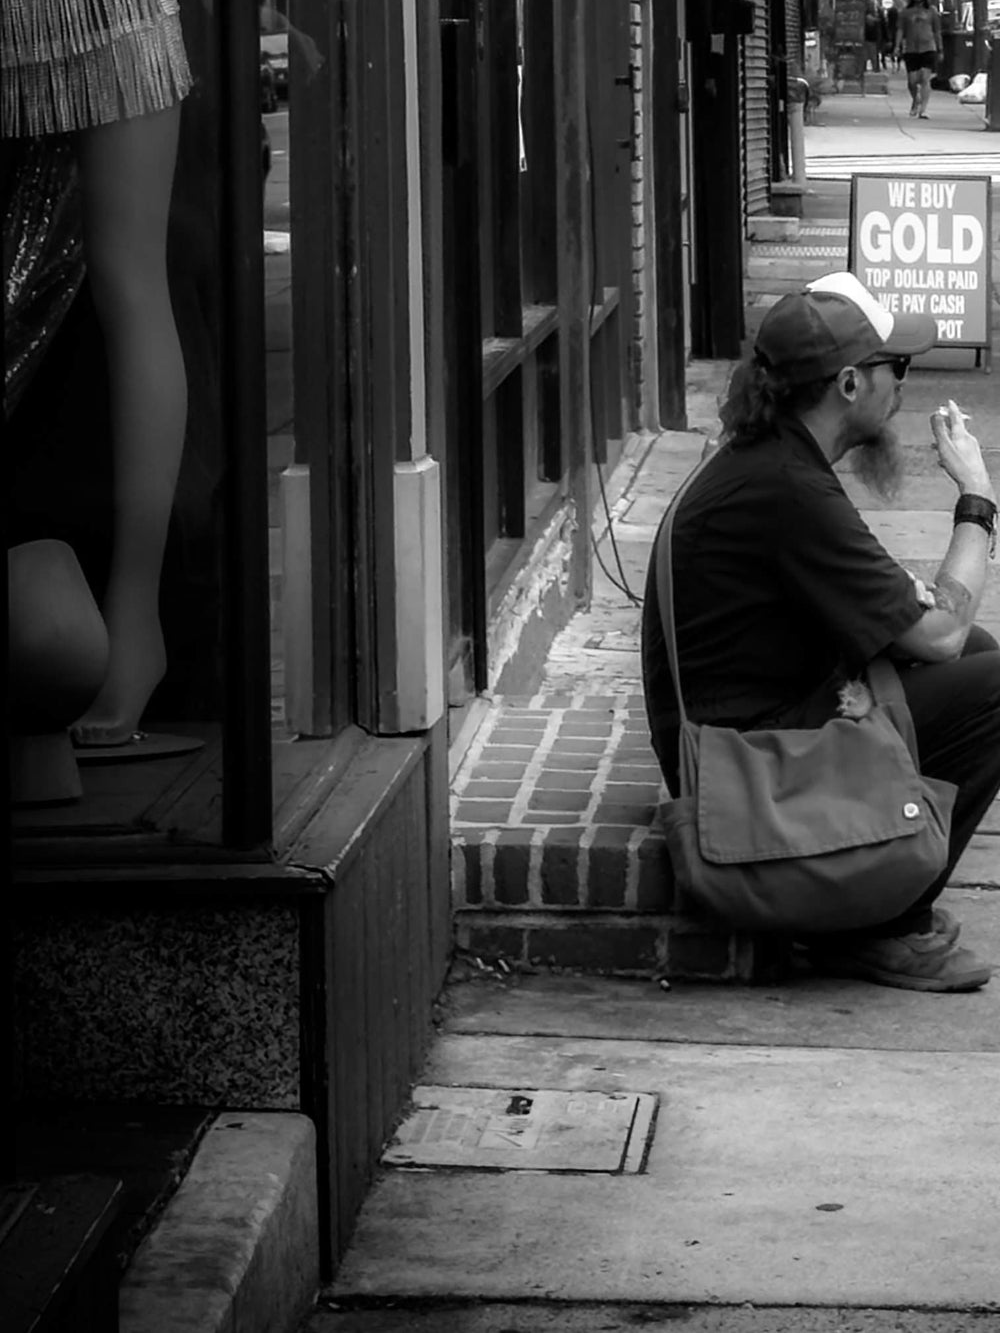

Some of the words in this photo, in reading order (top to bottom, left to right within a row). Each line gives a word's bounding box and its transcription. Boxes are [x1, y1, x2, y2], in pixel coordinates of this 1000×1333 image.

[888, 182, 915, 207] WE
[920, 183, 956, 208] BUY
[860, 211, 983, 264] GOLD
[865, 268, 890, 287] TOP
[894, 269, 944, 289] DOLLAR
[948, 270, 978, 290] PAID
[878, 293, 899, 313] WE
[902, 294, 927, 314] PAY
[930, 295, 965, 314] CASH
[935, 319, 964, 339] POT
